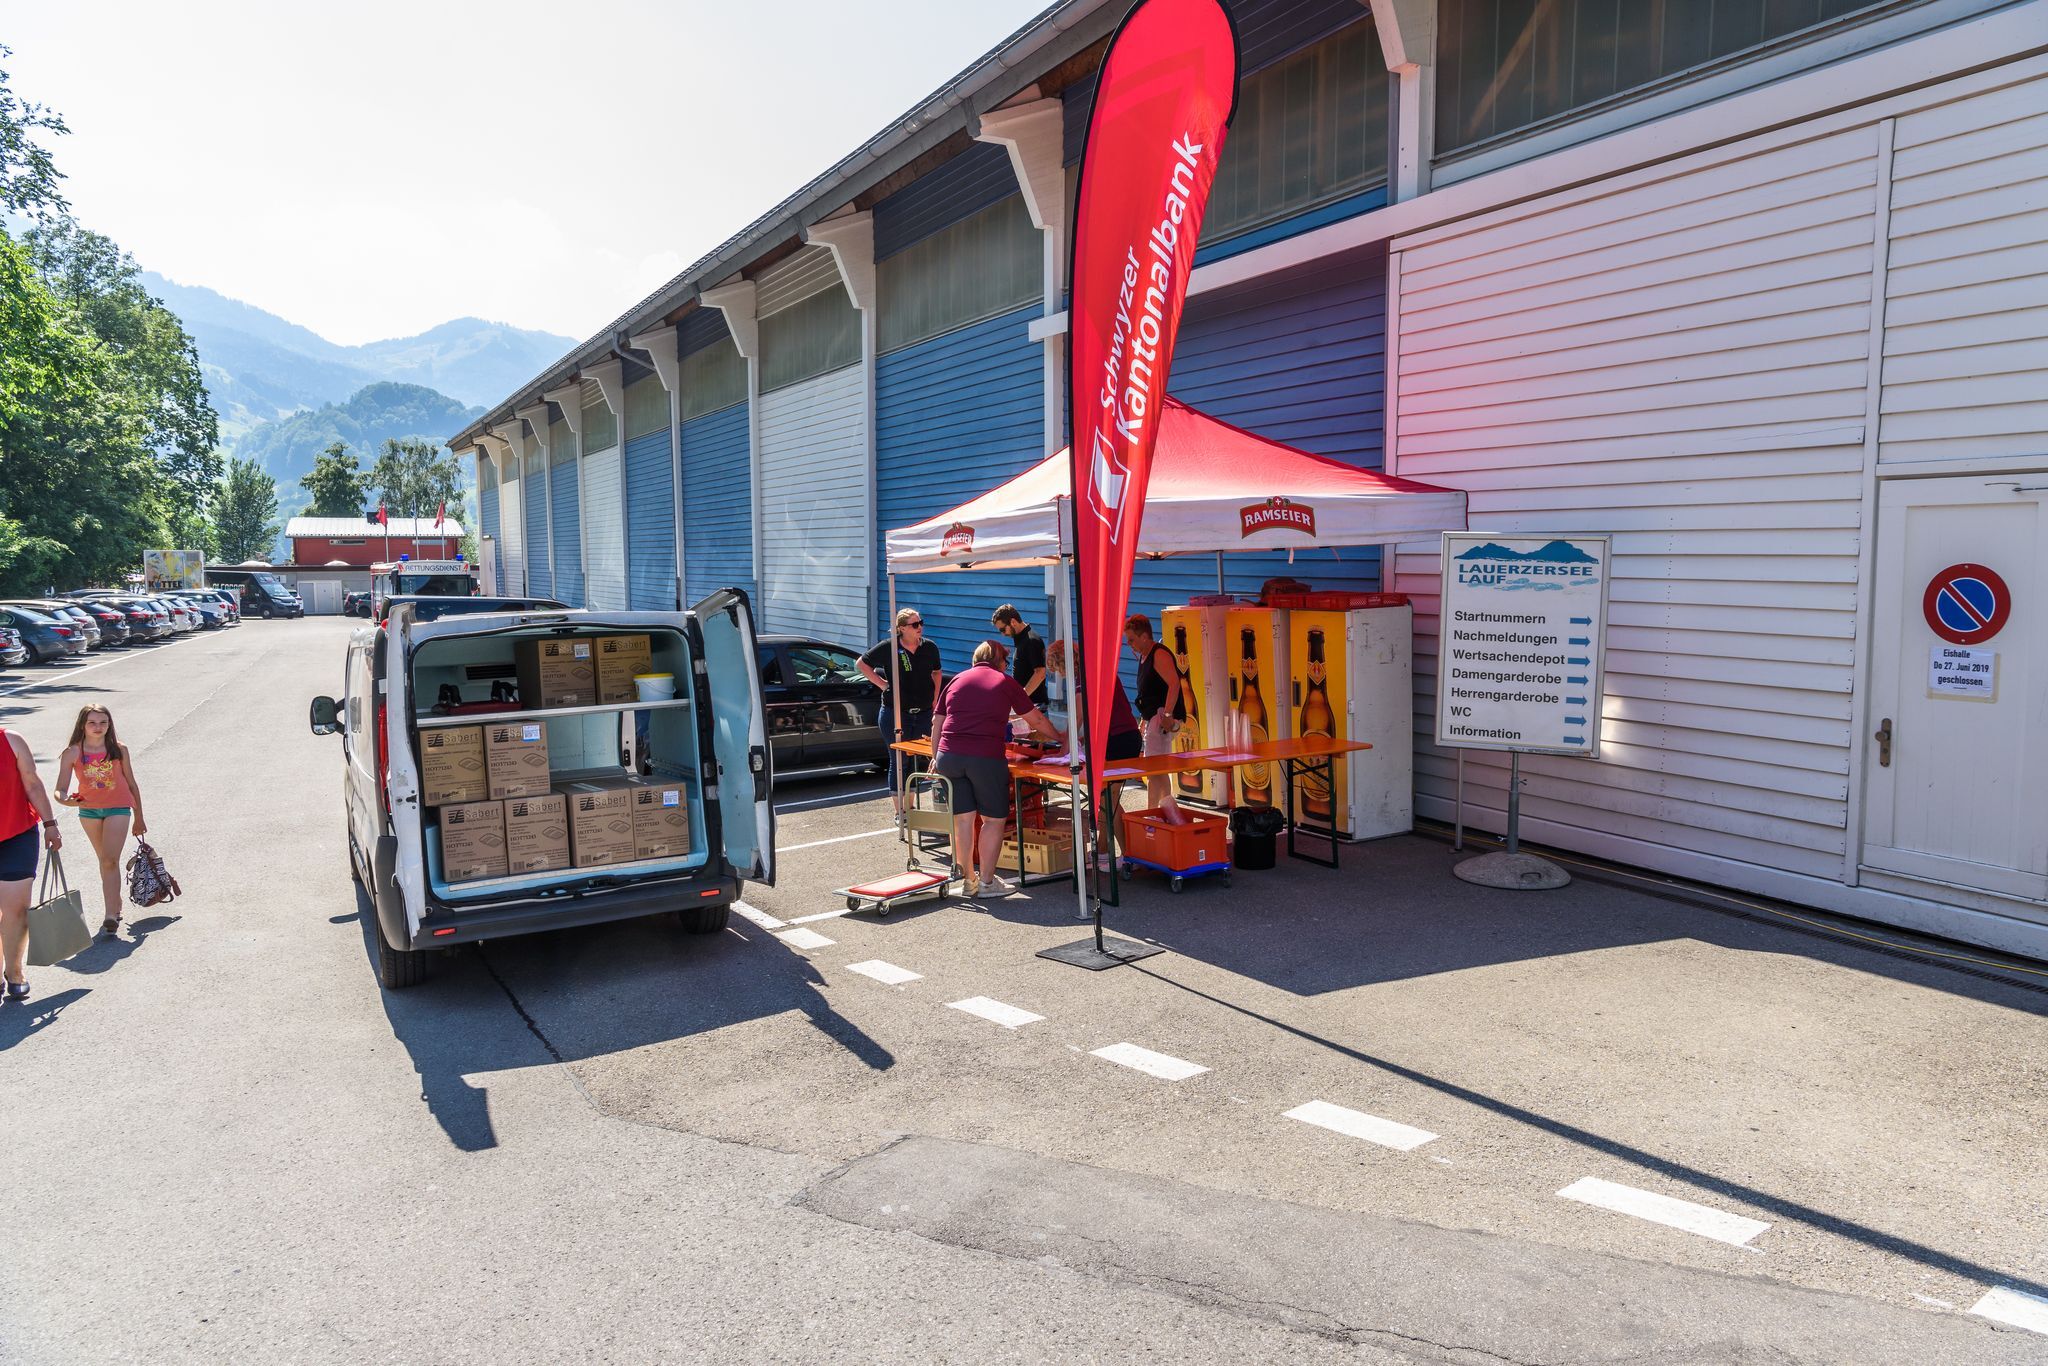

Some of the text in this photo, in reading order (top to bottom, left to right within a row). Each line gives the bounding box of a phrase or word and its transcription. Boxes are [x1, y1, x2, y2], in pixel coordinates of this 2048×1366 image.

[1115, 131, 1204, 446] Kantonalbank
[1101, 244, 1141, 417] Schwyzer
[1244, 509, 1311, 527] RAMSEIER
[405, 564, 462, 572] RETTUNGSDIENST
[1459, 564, 1593, 577] LAUERZERSEE
[1458, 574, 1506, 585] LAUF
[1454, 610, 1546, 624] Startnummern
[1453, 630, 1557, 646] Nachmeldungen
[1453, 649, 1565, 668] Wertsachendepot
[1943, 649, 1970, 658] Eishalle
[1934, 661, 1989, 672] Do 27. Juni 2019
[1452, 668, 1562, 685] Damengarderobe
[1937, 675, 1983, 686] geschlossen
[1451, 687, 1559, 704] Herrengarderobe
[1450, 706, 1472, 717] WC
[444, 733, 478, 744] Sabert
[1449, 725, 1521, 740] Information
[528, 801, 561, 812] Sabert
[595, 795, 626, 806] Sabert
[465, 808, 499, 819] Sabert
